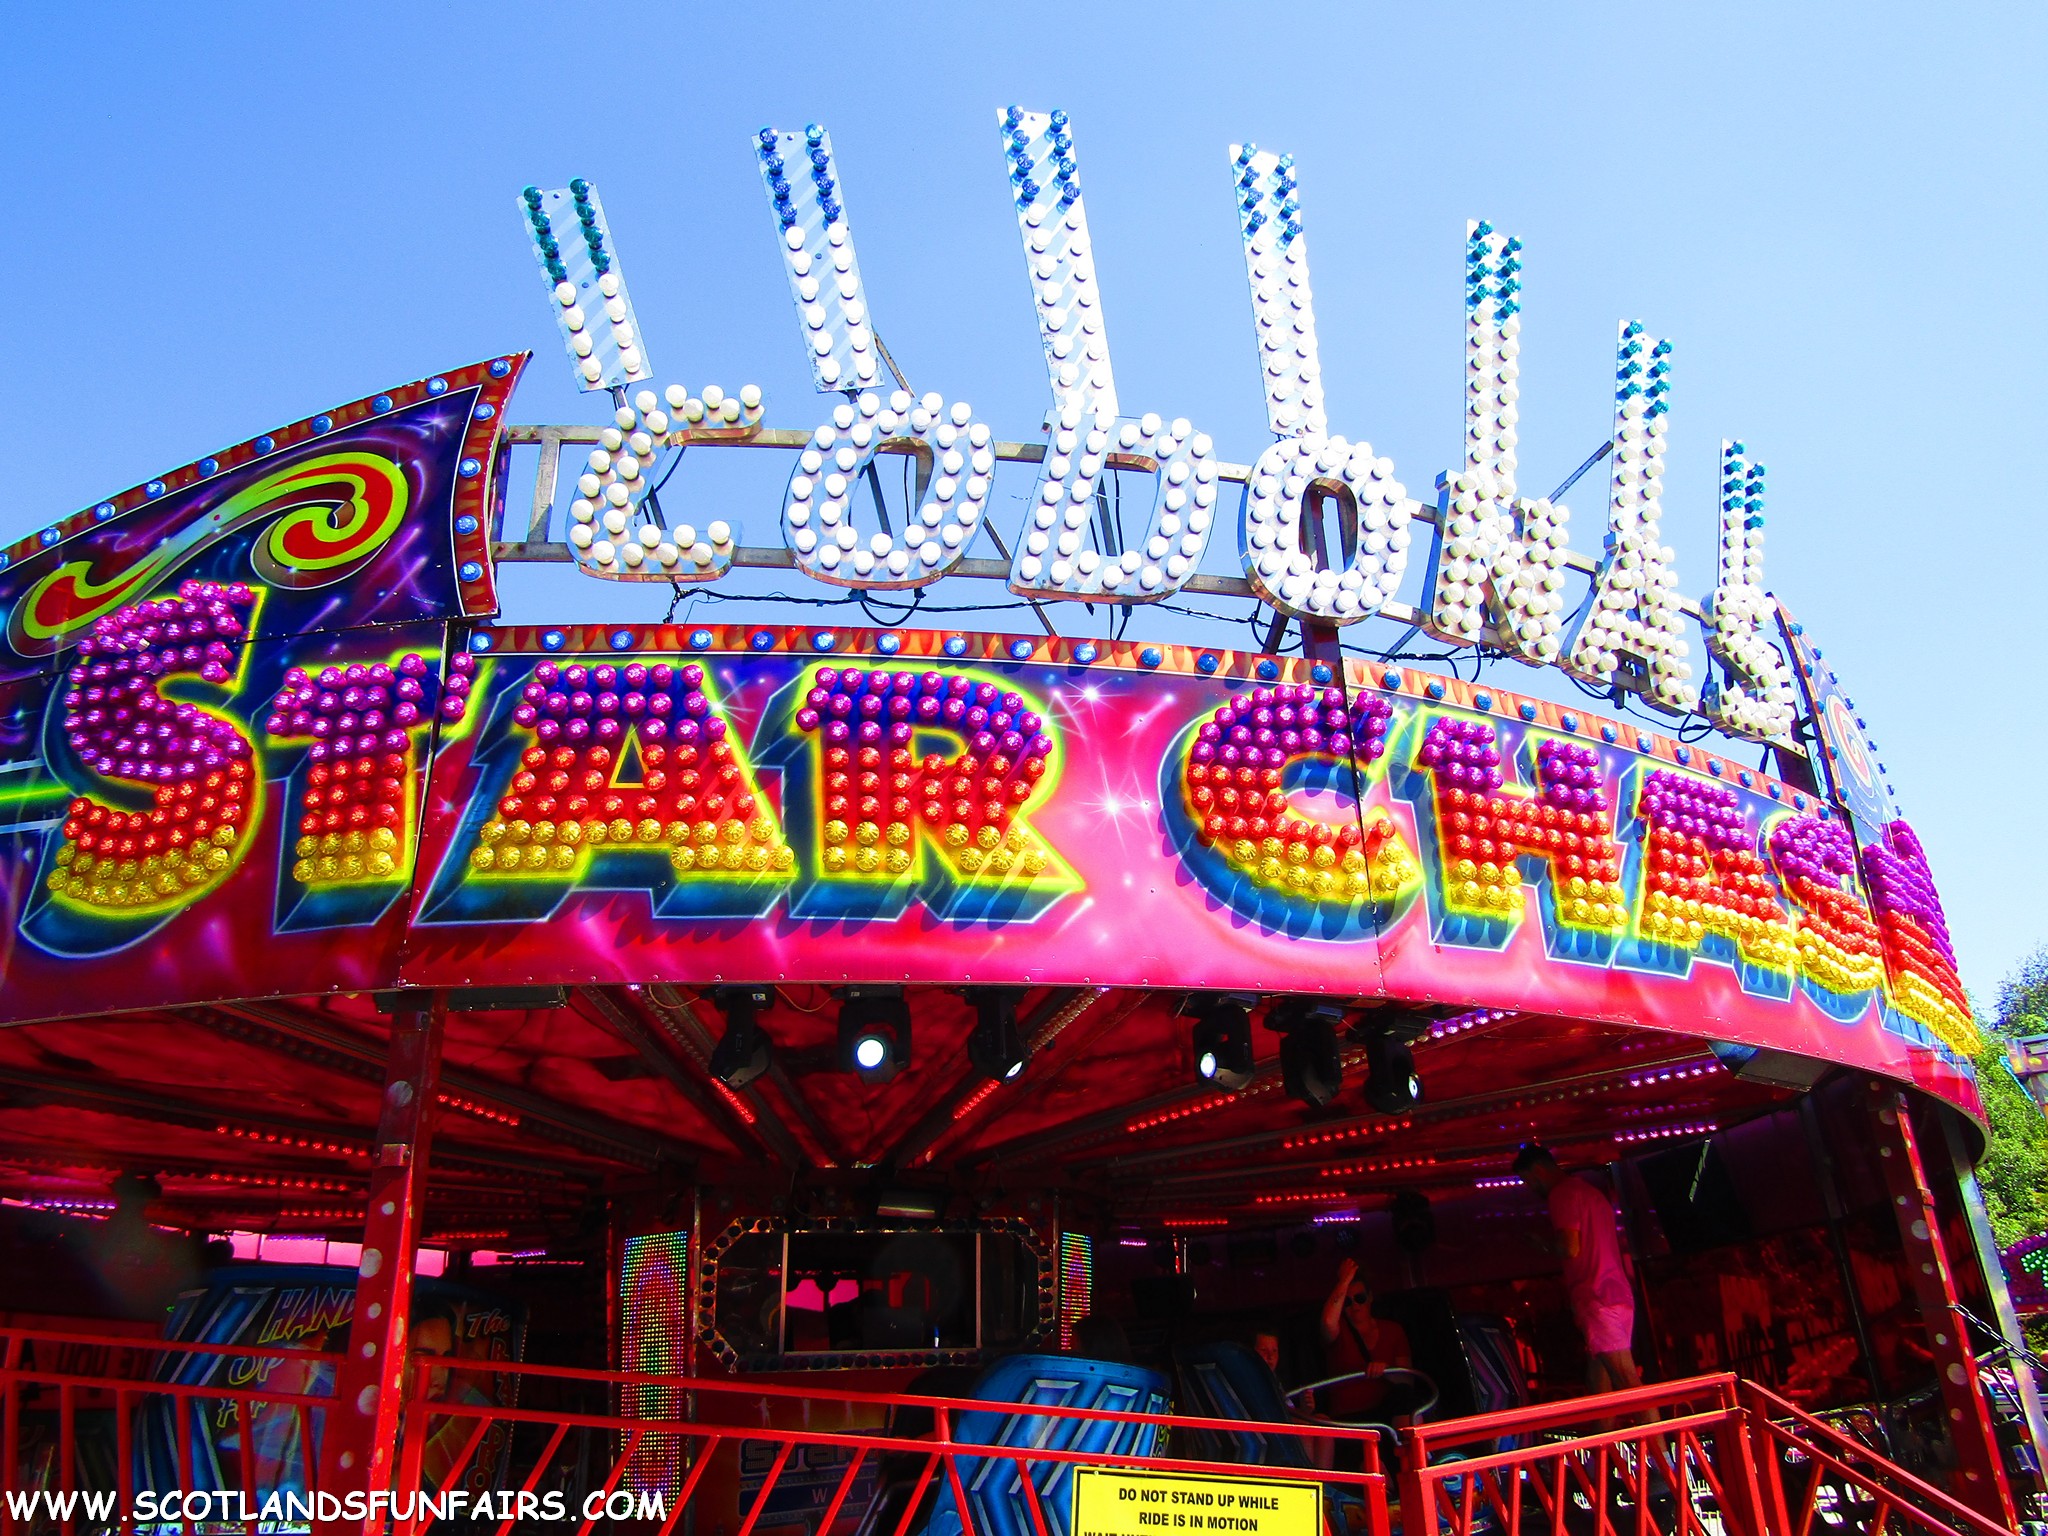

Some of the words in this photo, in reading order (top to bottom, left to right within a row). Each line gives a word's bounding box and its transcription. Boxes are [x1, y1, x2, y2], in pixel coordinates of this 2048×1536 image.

[38, 576, 1084, 918] STAR
[1118, 1487, 1137, 1501] DO
[1141, 1489, 1169, 1503] NOT
[1171, 1491, 1214, 1506] STAND
[1217, 1494, 1235, 1508] UP
[1238, 1495, 1279, 1511] WHILE
[1139, 1511, 1169, 1526] RIDE
[1173, 1513, 1186, 1528] IS
[1189, 1514, 1203, 1529] IN
[1207, 1515, 1258, 1532] MOTION
